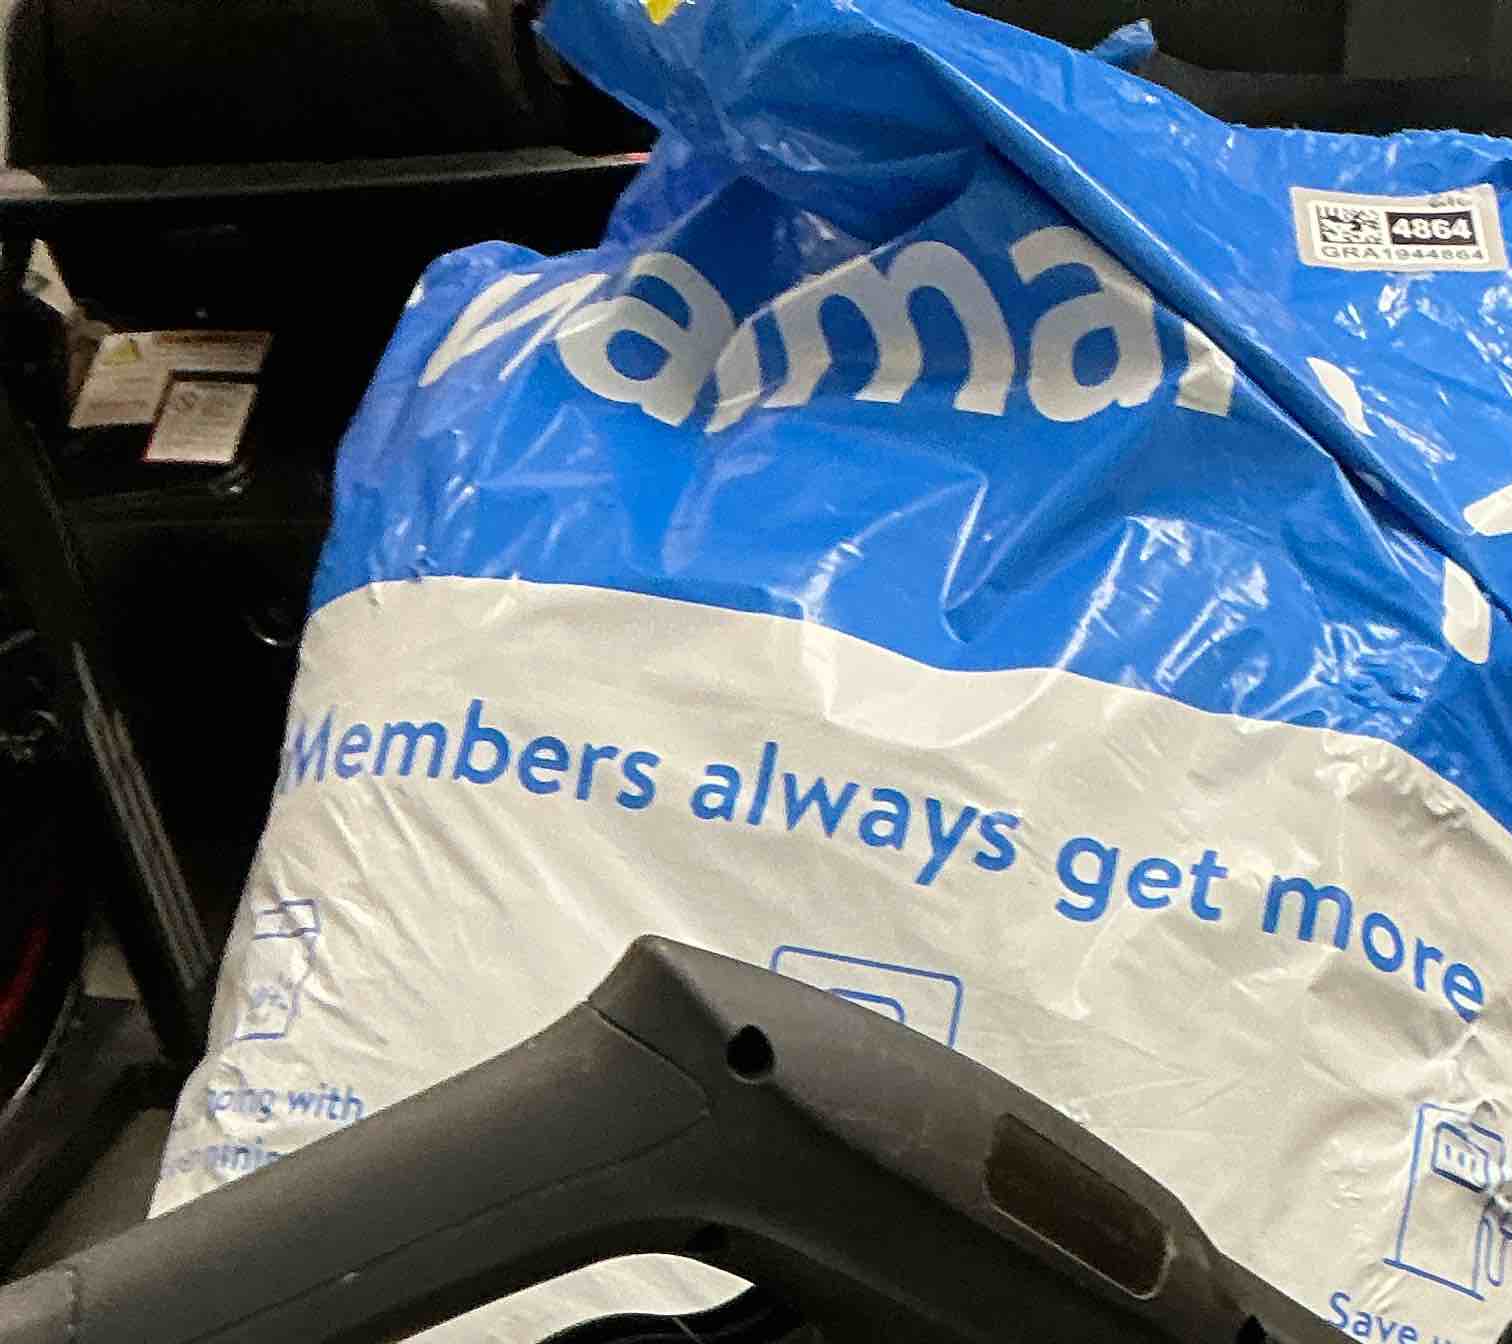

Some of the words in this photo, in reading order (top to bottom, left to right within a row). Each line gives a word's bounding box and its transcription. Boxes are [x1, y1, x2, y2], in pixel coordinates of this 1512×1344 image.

[1392, 218, 1472, 240] 4864
[1321, 247, 1484, 261] GRA1944864
[285, 698, 661, 810] Members
[690, 740, 1020, 885] always
[1055, 837, 1228, 922] get
[1262, 875, 1484, 1023] more
[287, 1082, 366, 1122] with
